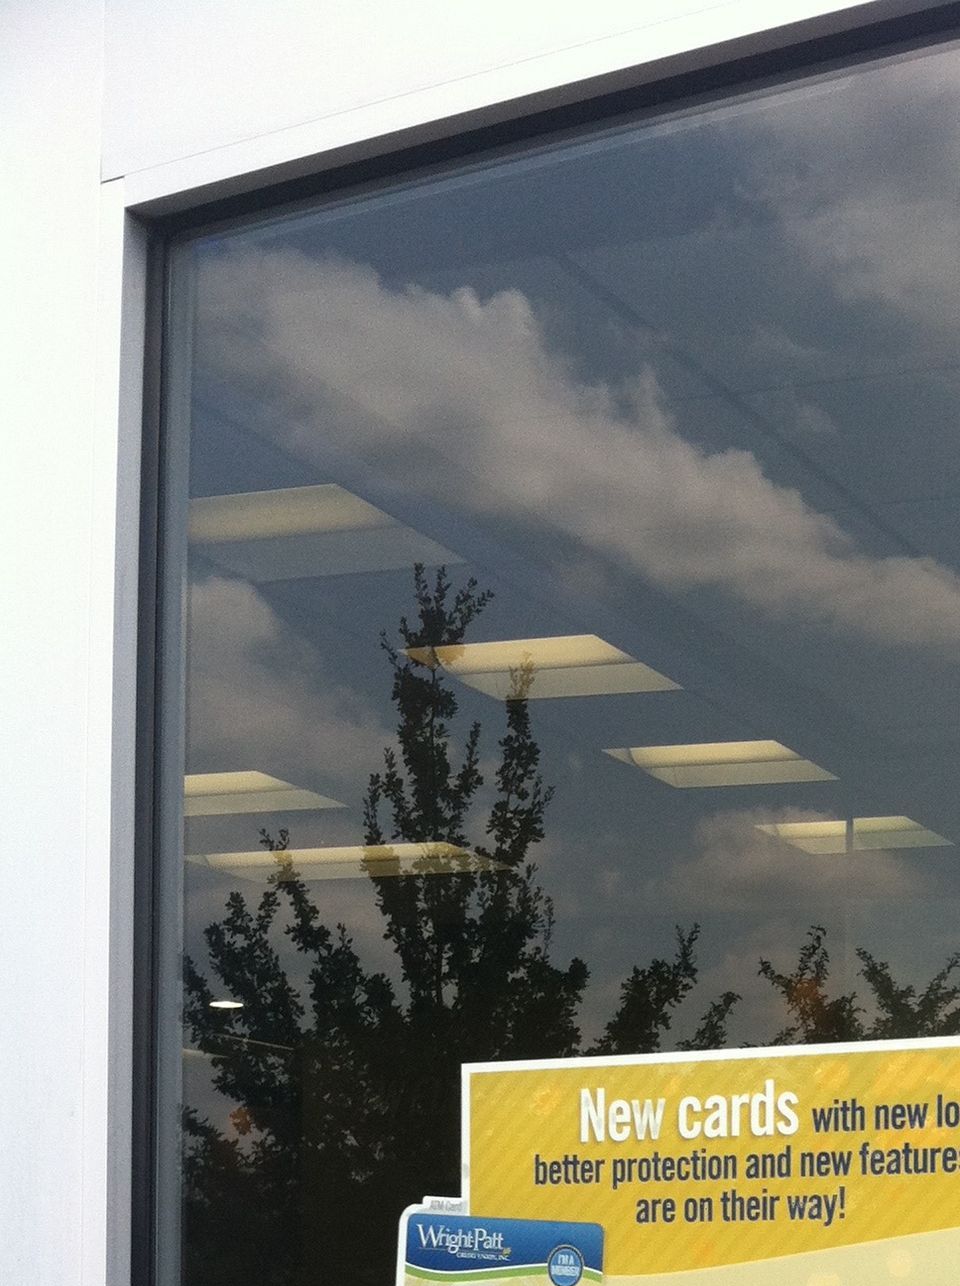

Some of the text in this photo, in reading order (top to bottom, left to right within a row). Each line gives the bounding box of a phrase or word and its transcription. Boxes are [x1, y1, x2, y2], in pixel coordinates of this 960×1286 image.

[580, 1087, 665, 1143] New
[678, 1079, 799, 1138] cards
[812, 1098, 866, 1133] with
[874, 1099, 928, 1130] new
[534, 1154, 605, 1186] better
[612, 1148, 738, 1190] protection
[745, 1145, 791, 1179] and
[800, 1150, 852, 1177] new
[636, 1186, 847, 1227] are on their way!
